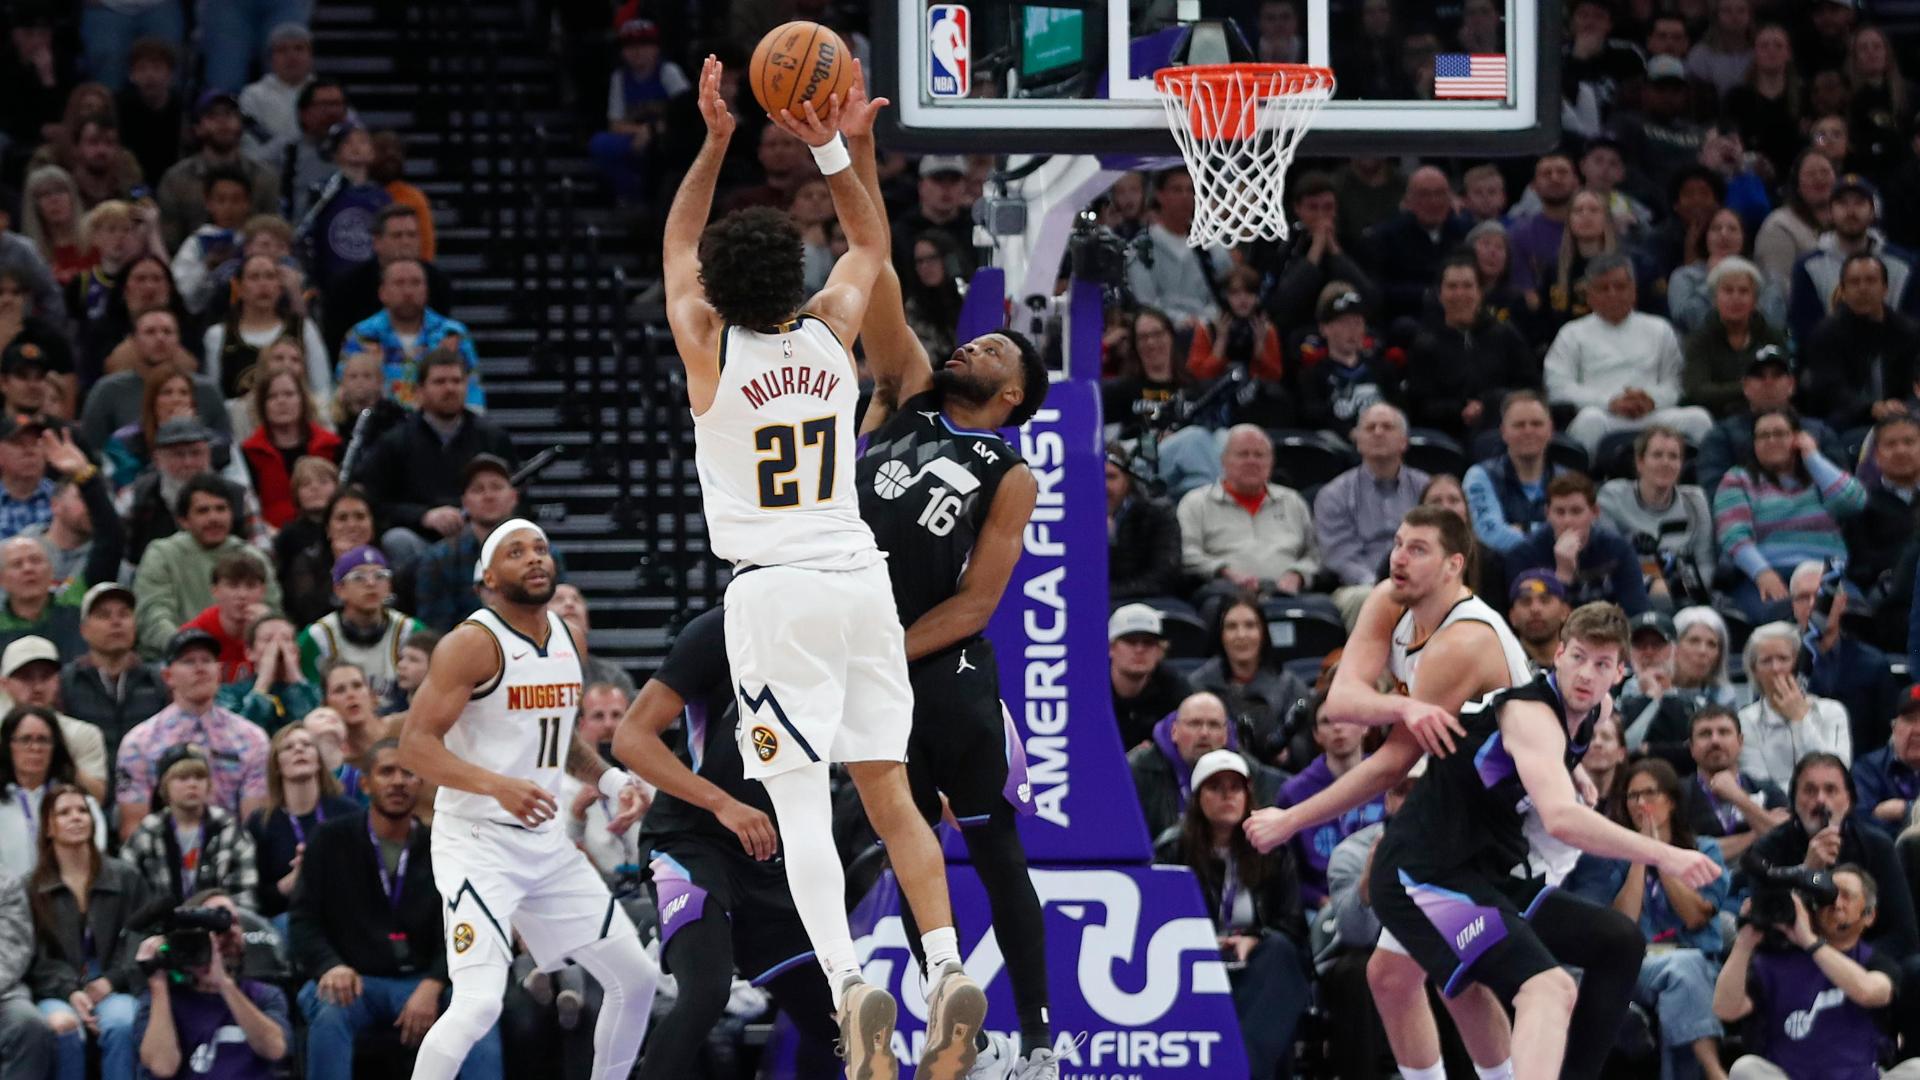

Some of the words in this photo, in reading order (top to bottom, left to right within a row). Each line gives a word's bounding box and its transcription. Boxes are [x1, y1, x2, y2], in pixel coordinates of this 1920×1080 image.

[797, 42, 834, 104] Wilson
[934, 76, 954, 92] NBA
[740, 366, 840, 410] MURRAY
[752, 412, 838, 511] 27
[971, 440, 1000, 465] LVT
[1019, 408, 1066, 557] FIRST
[916, 486, 962, 537] 16
[1023, 565, 1070, 828] AMERICA
[537, 716, 561, 769] 11
[662, 893, 690, 925] UTAH
[1456, 915, 1485, 951] UTAH
[1090, 1032, 1220, 1067] FIRST
